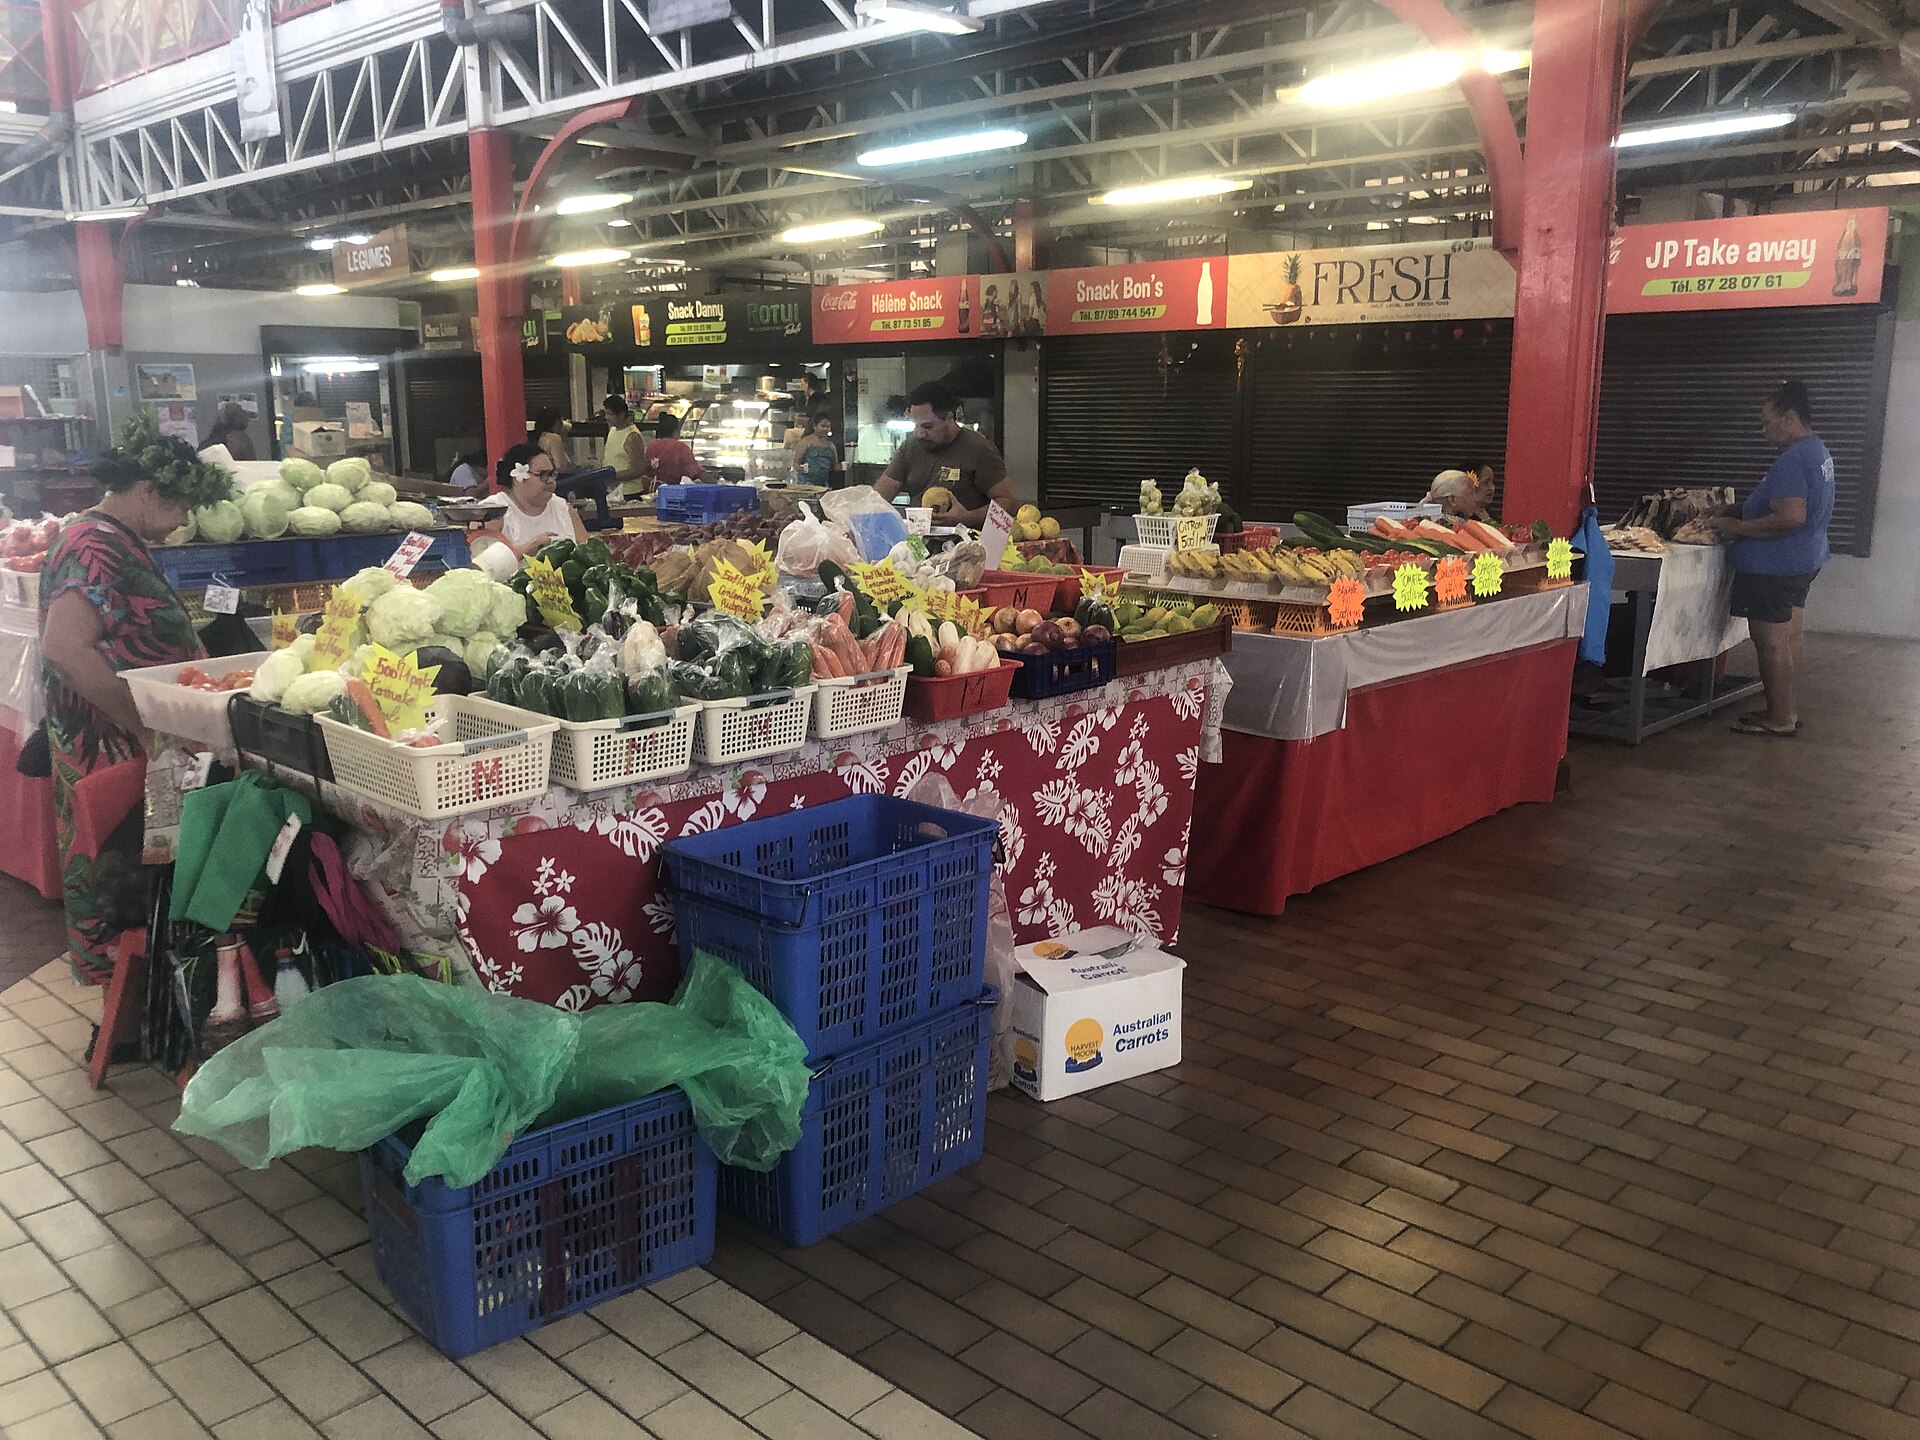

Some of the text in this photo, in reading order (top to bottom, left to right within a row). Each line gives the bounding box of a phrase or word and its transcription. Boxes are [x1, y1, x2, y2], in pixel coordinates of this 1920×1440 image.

[1646, 239, 1679, 270] JP
[1683, 238, 1740, 267] Take
[1746, 238, 1816, 268] away
[1077, 274, 1163, 303] Snack Bon's
[1312, 253, 1452, 306] FRESH
[1670, 274, 1782, 293] Tél. 87 28 07 61
[668, 300, 724, 322] Snack Danny
[872, 290, 943, 313] Hélène Snack
[893, 320, 901, 329] 87
[903, 319, 911, 328] 73
[914, 319, 921, 328] 51
[1121, 308, 1137, 319] 744
[1140, 307, 1156, 317] 547
[1179, 517, 1204, 534] CITRON
[1012, 587, 1029, 609] M
[960, 675, 986, 710] M
[473, 757, 502, 798] M
[1113, 1011, 1172, 1036] Australian
[1070, 1041, 1099, 1052] HARVEST
[1115, 1028, 1169, 1053] Carrots
[1074, 1049, 1097, 1059] MOON
